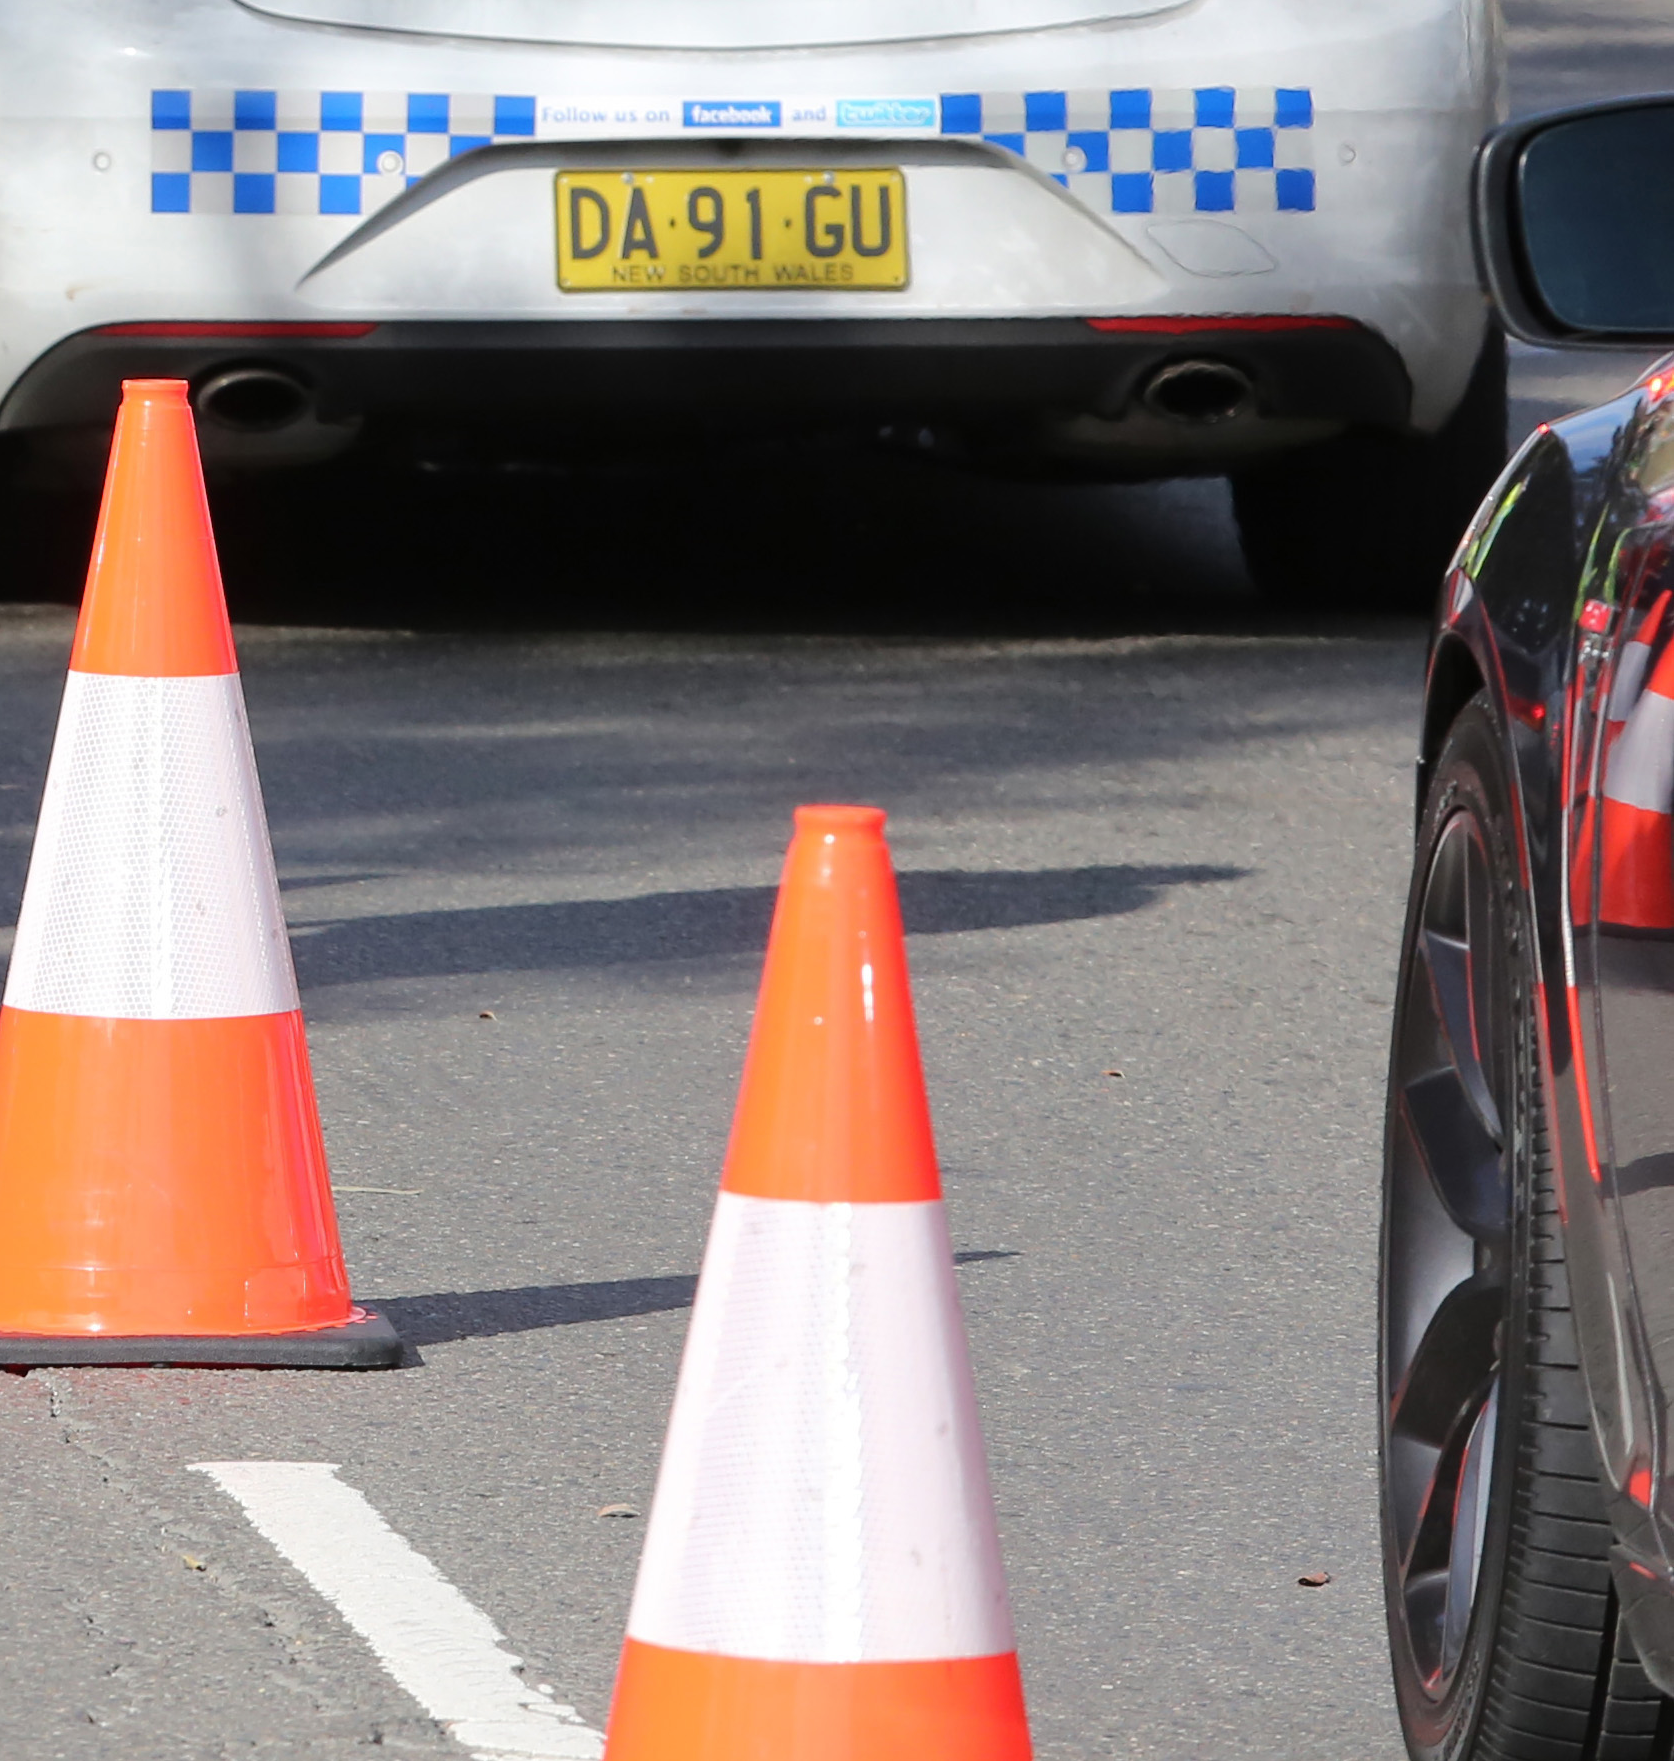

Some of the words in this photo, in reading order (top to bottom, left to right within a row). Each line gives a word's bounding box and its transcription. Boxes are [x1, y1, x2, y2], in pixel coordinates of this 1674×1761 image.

[541, 105, 607, 124] Follow
[615, 109, 638, 124] us
[644, 109, 671, 124] on
[691, 104, 772, 124] facebook
[792, 105, 827, 123] and
[842, 103, 931, 126] twitter
[611, 265, 665, 282] NEW
[678, 265, 759, 282] SOUTH
[774, 264, 853, 282] WALES
